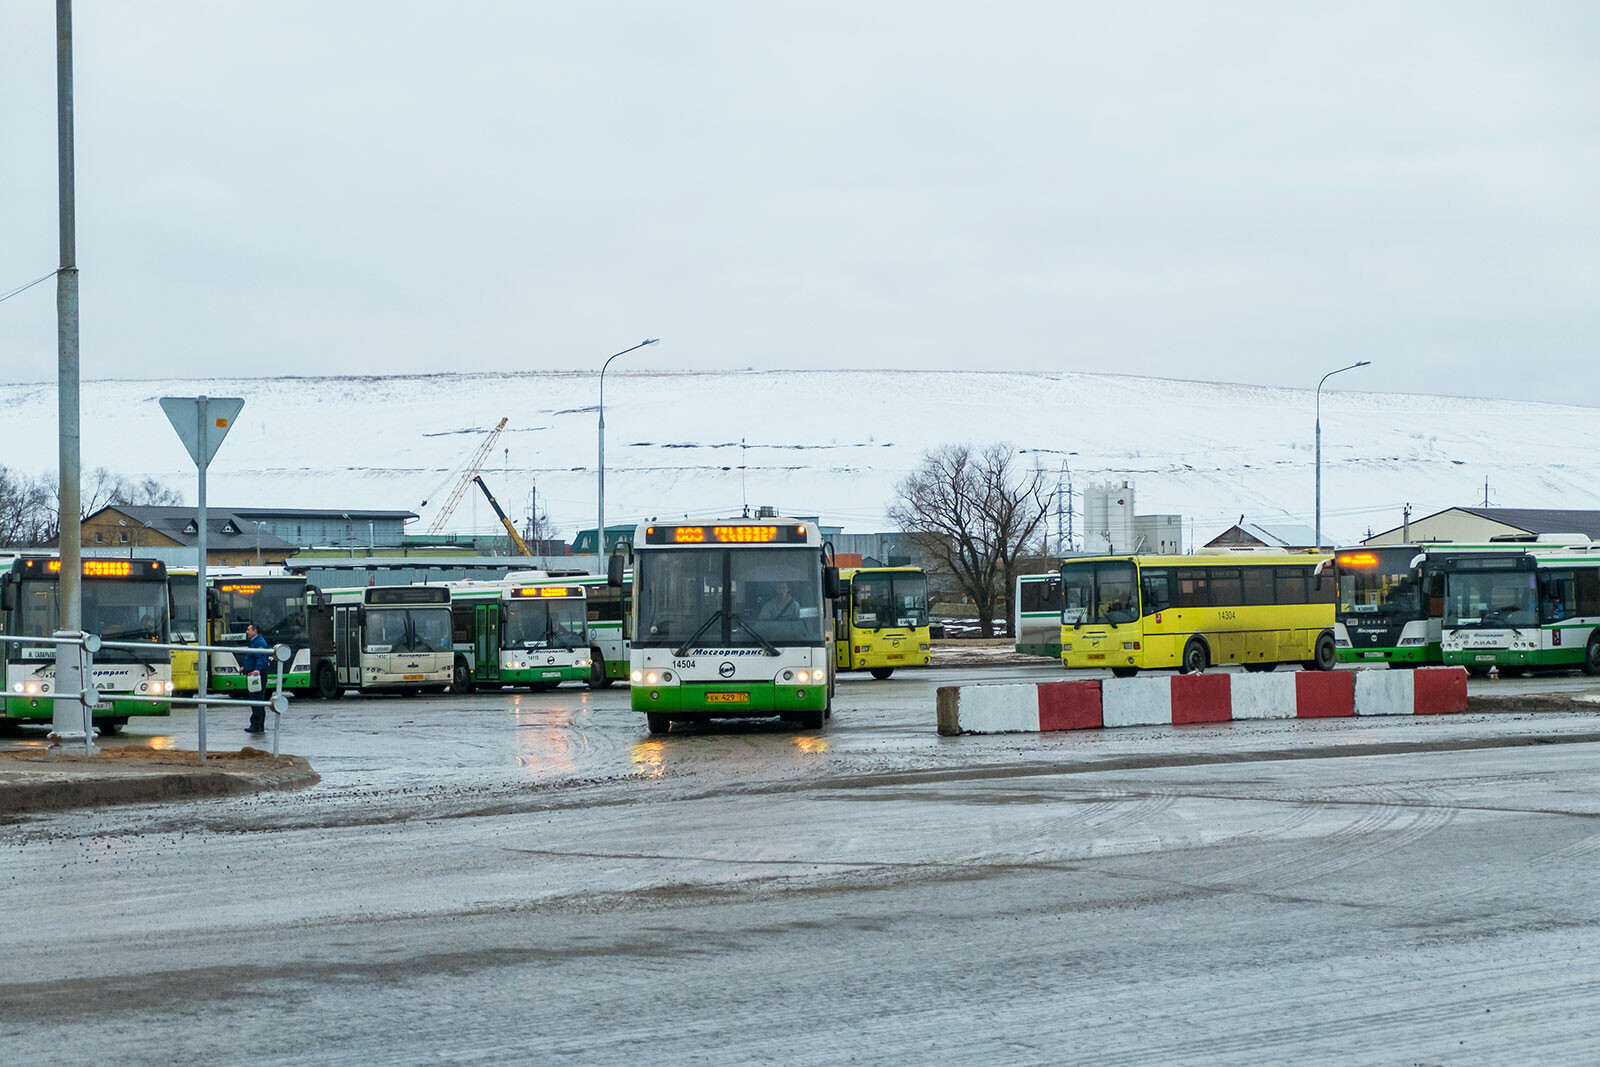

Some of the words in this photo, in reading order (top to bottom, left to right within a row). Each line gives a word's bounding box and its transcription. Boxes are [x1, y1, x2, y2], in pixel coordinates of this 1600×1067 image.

[1218, 610, 1236, 620] 14304
[691, 648, 763, 657] Мосгортранс
[672, 659, 696, 669] 14504
[721, 693, 735, 701] 429
